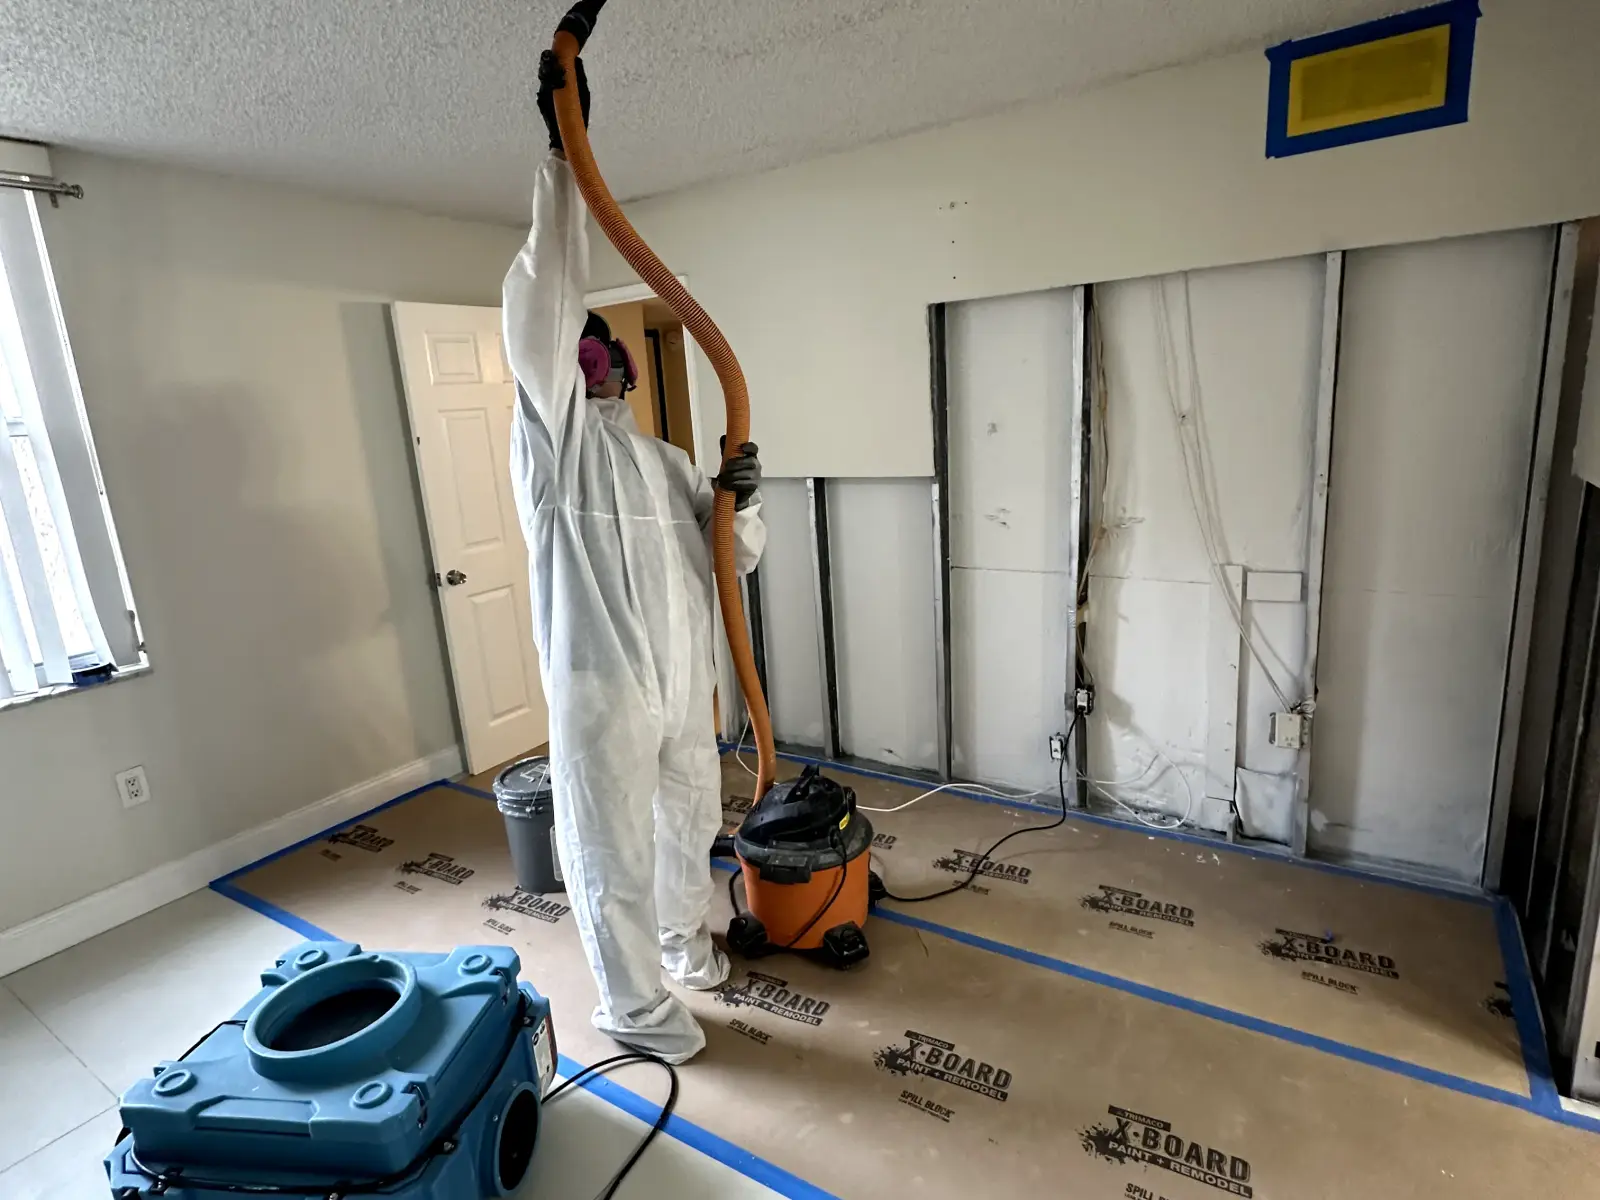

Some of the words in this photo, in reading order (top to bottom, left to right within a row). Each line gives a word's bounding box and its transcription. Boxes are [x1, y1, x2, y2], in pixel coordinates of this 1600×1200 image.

[733, 993, 761, 1007] PAINT
[770, 1005, 821, 1026] REMODEL
[896, 1057, 931, 1074] PAINT
[943, 1073, 1005, 1101] REMODEL
[900, 1090, 923, 1106] SPILL
[924, 1100, 951, 1118] BLOCK
[1124, 1110, 1165, 1130] TRIMACO
[1108, 1139, 1152, 1162] PAINT
[1169, 1161, 1251, 1198] REMODEL
[1126, 1182, 1154, 1200] SPILL
